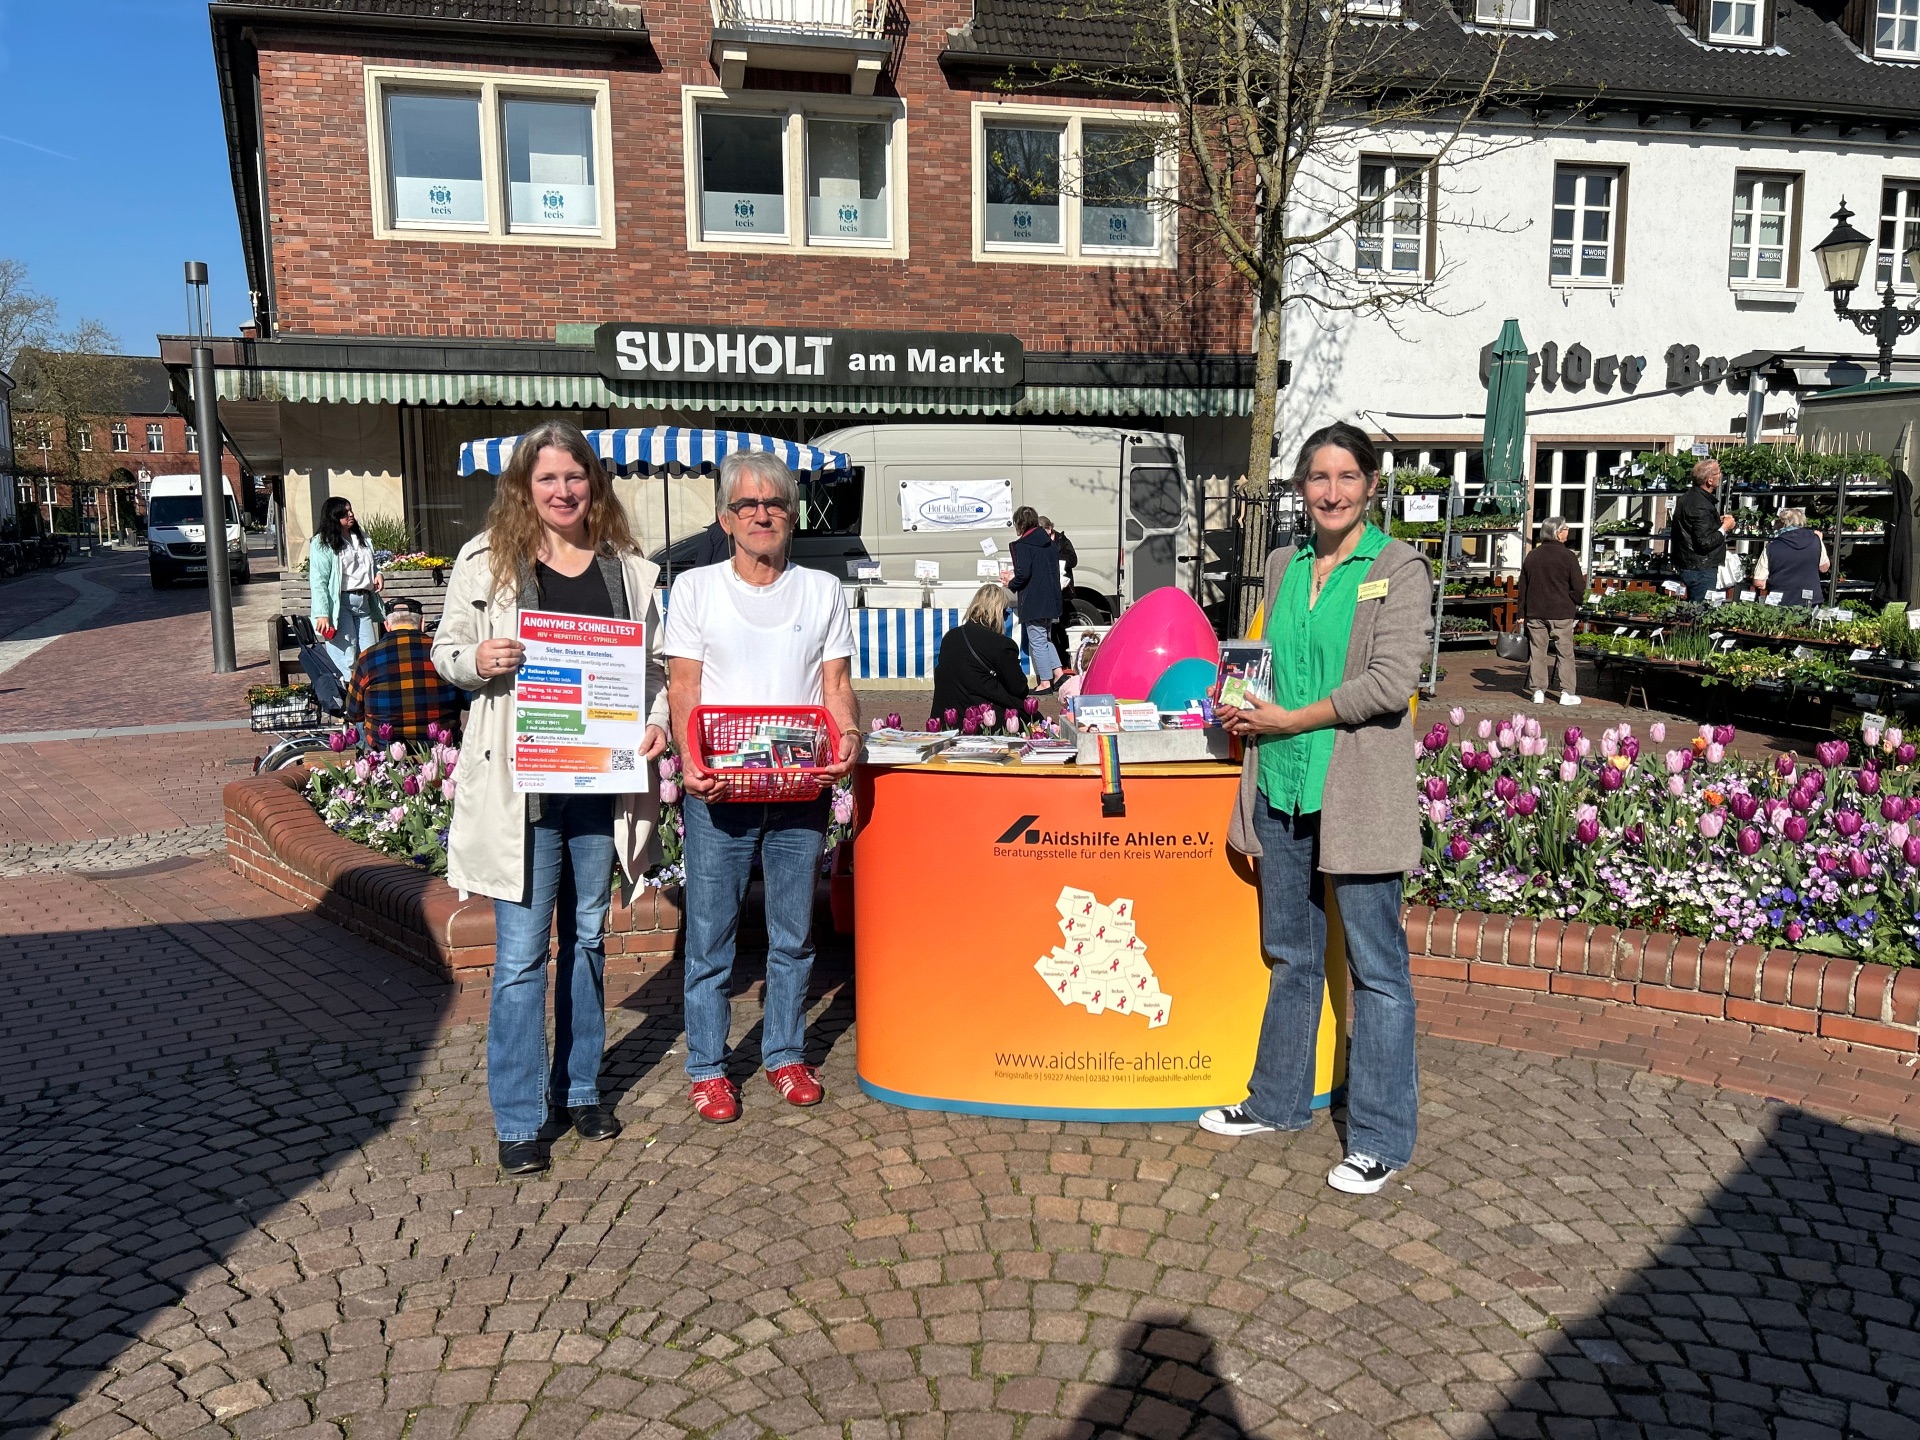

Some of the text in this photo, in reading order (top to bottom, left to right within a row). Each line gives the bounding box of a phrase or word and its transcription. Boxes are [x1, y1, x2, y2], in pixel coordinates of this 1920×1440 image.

[431, 206, 451, 215] tecis
[544, 211, 564, 219] tecis
[735, 219, 754, 228] tecis
[839, 224, 857, 232] tecis
[1014, 230, 1031, 238] tecis
[616, 330, 1005, 376] SUDHOLT am Markt
[929, 504, 940, 512] Hof
[523, 617, 636, 636] ANONYMER SCHNELLTEST
[554, 633, 582, 641] HEPATITIS
[593, 636, 618, 644] SYPHILIS
[1041, 831, 1214, 846] Aidshilfe Ahlen e.V.
[993, 847, 1213, 860] Beratungsstelle für den Kreis Warendorf
[995, 1051, 1212, 1071] www.aidshilfe-ahlen.de
[994, 1071, 1033, 1080] Königstraße
[1065, 1074, 1085, 1082] Ahlen
[1089, 1074, 1109, 1082] 02382
[1111, 1074, 1131, 1082] 19411
